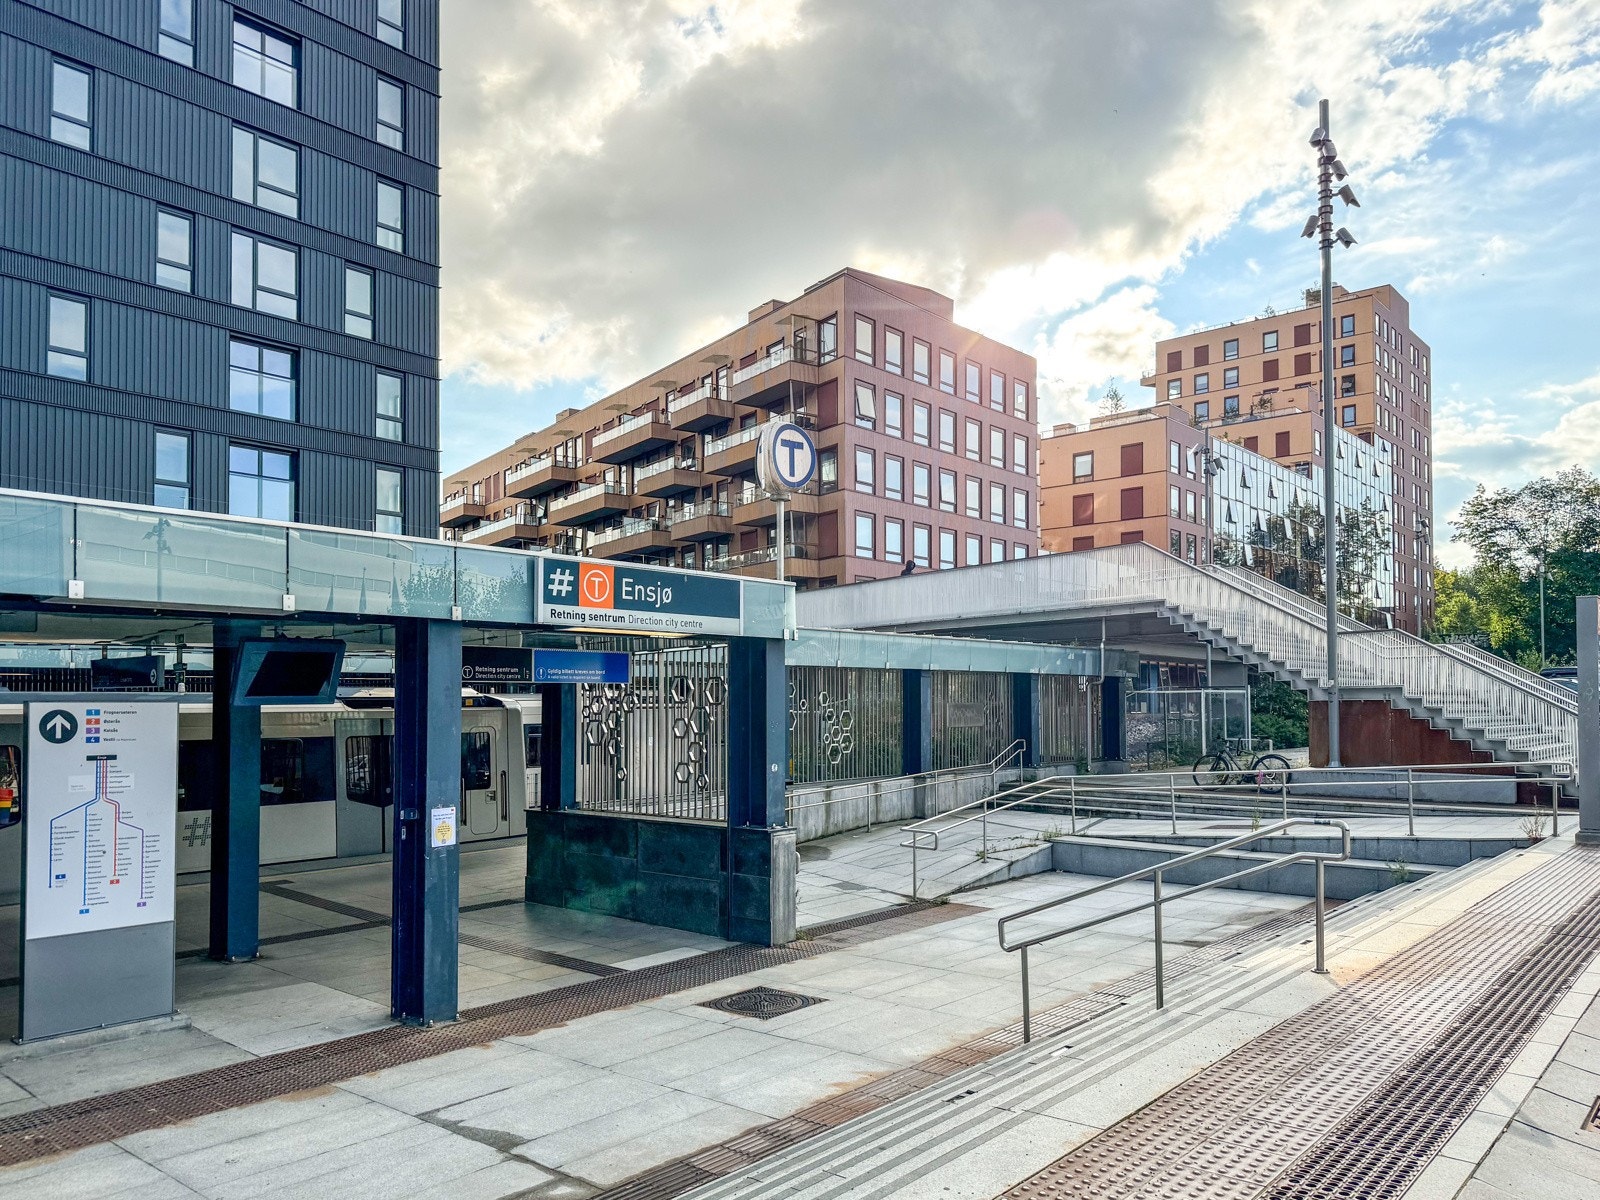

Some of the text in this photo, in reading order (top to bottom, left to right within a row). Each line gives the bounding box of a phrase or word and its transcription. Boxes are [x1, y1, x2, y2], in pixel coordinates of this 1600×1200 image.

[781, 439, 804, 477] T
[622, 577, 672, 607] Ensjø
[551, 608, 703, 629] Retning sentrum Direction city centre
